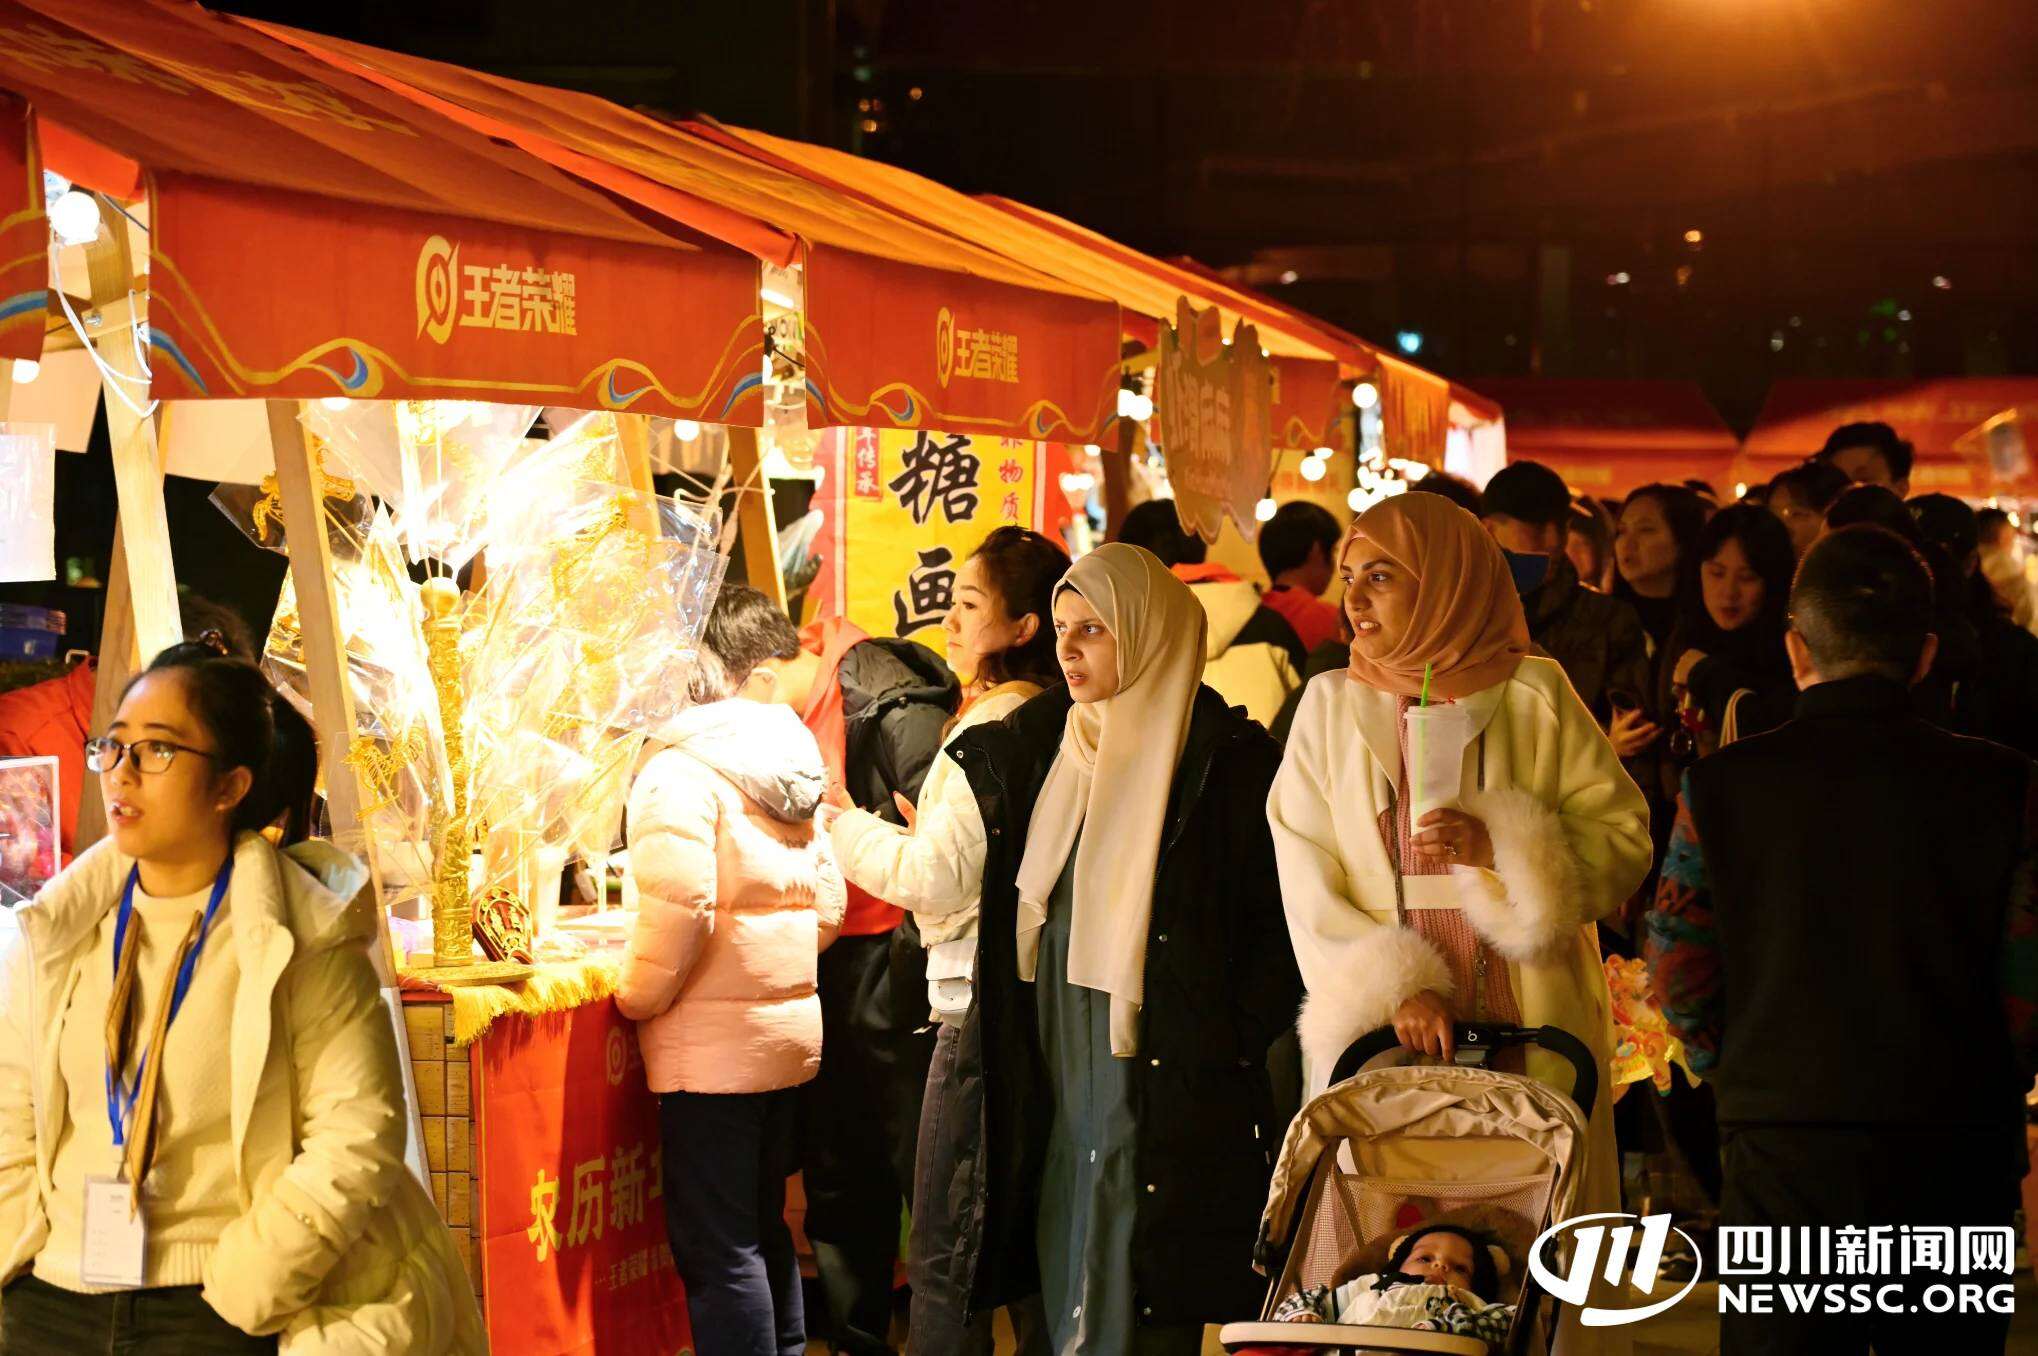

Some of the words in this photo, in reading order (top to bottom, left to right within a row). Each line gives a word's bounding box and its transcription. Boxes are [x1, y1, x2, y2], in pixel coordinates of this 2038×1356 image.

[459, 263, 578, 336] 王者荣耀
[954, 328, 1020, 384] 王者荣耀
[889, 430, 981, 638] 糖画
